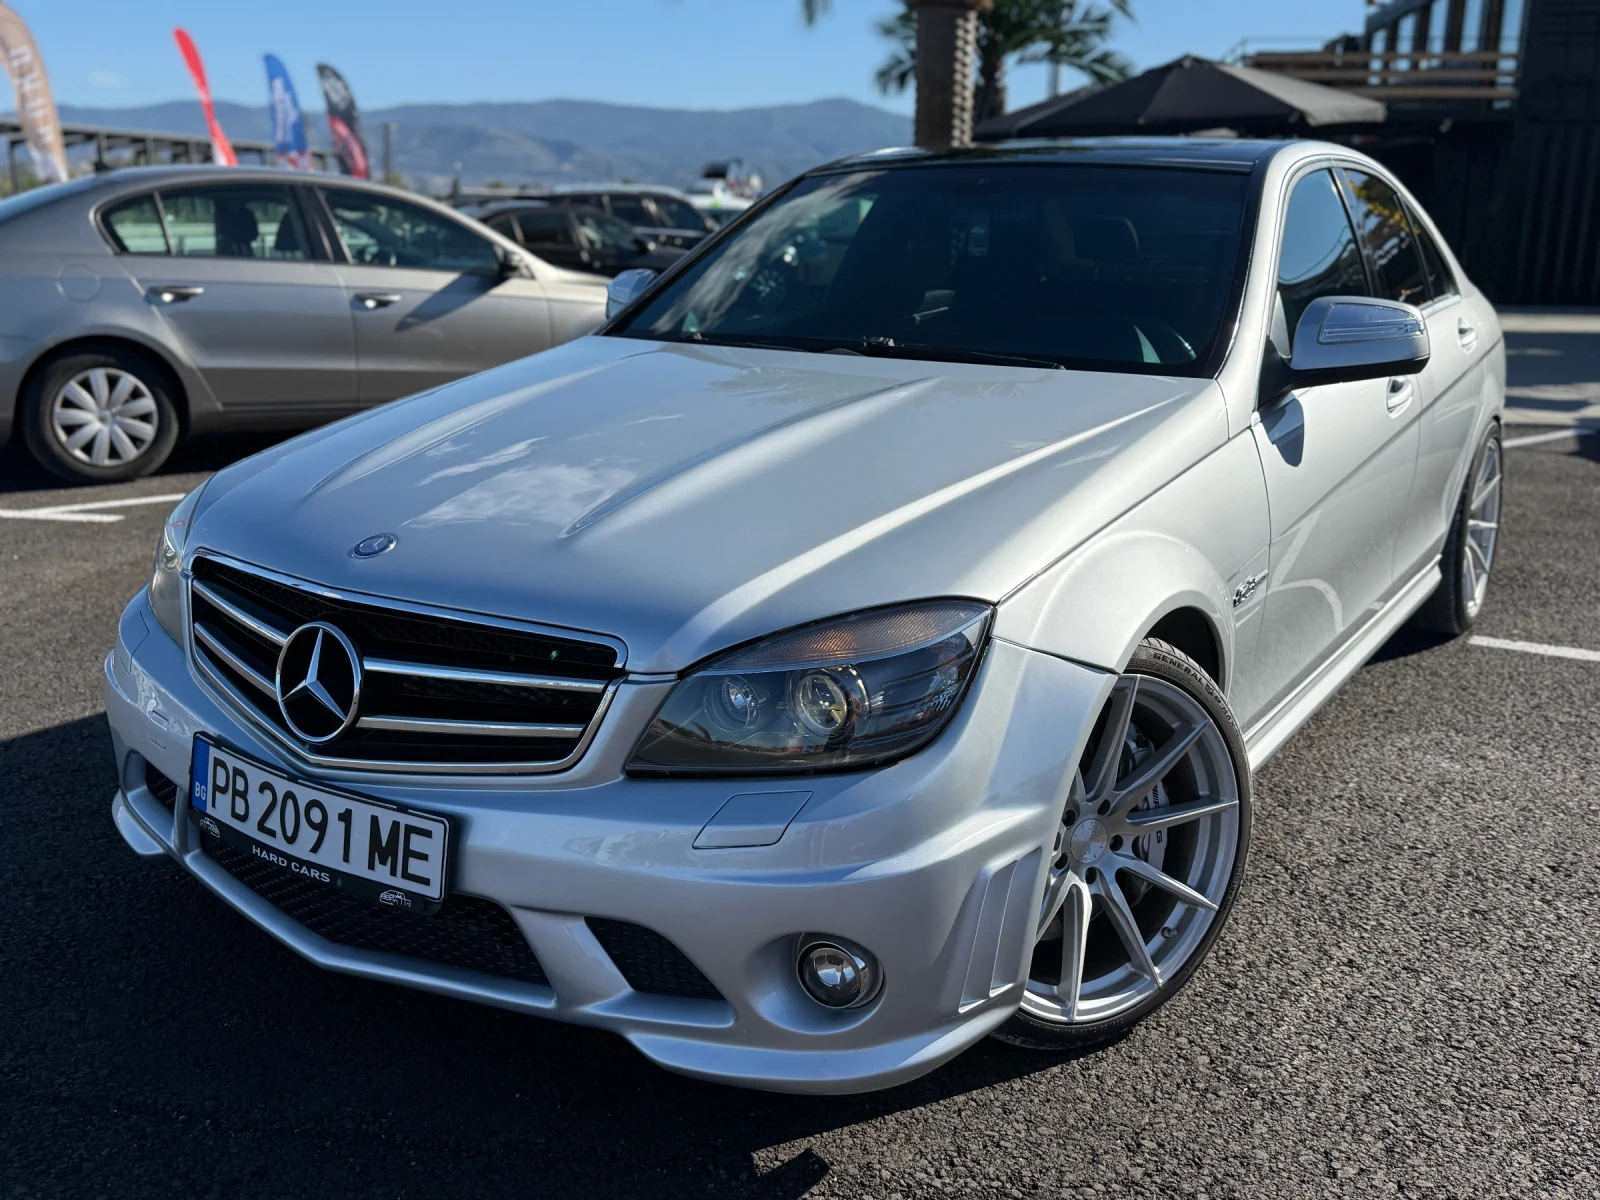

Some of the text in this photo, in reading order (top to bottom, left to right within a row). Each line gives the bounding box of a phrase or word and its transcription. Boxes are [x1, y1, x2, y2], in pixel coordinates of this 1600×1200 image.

[1153, 652, 1204, 686] GENERAL
[194, 781, 207, 801] BG
[211, 756, 433, 887] PB 2091 ME
[252, 844, 331, 883] HARD CARS
